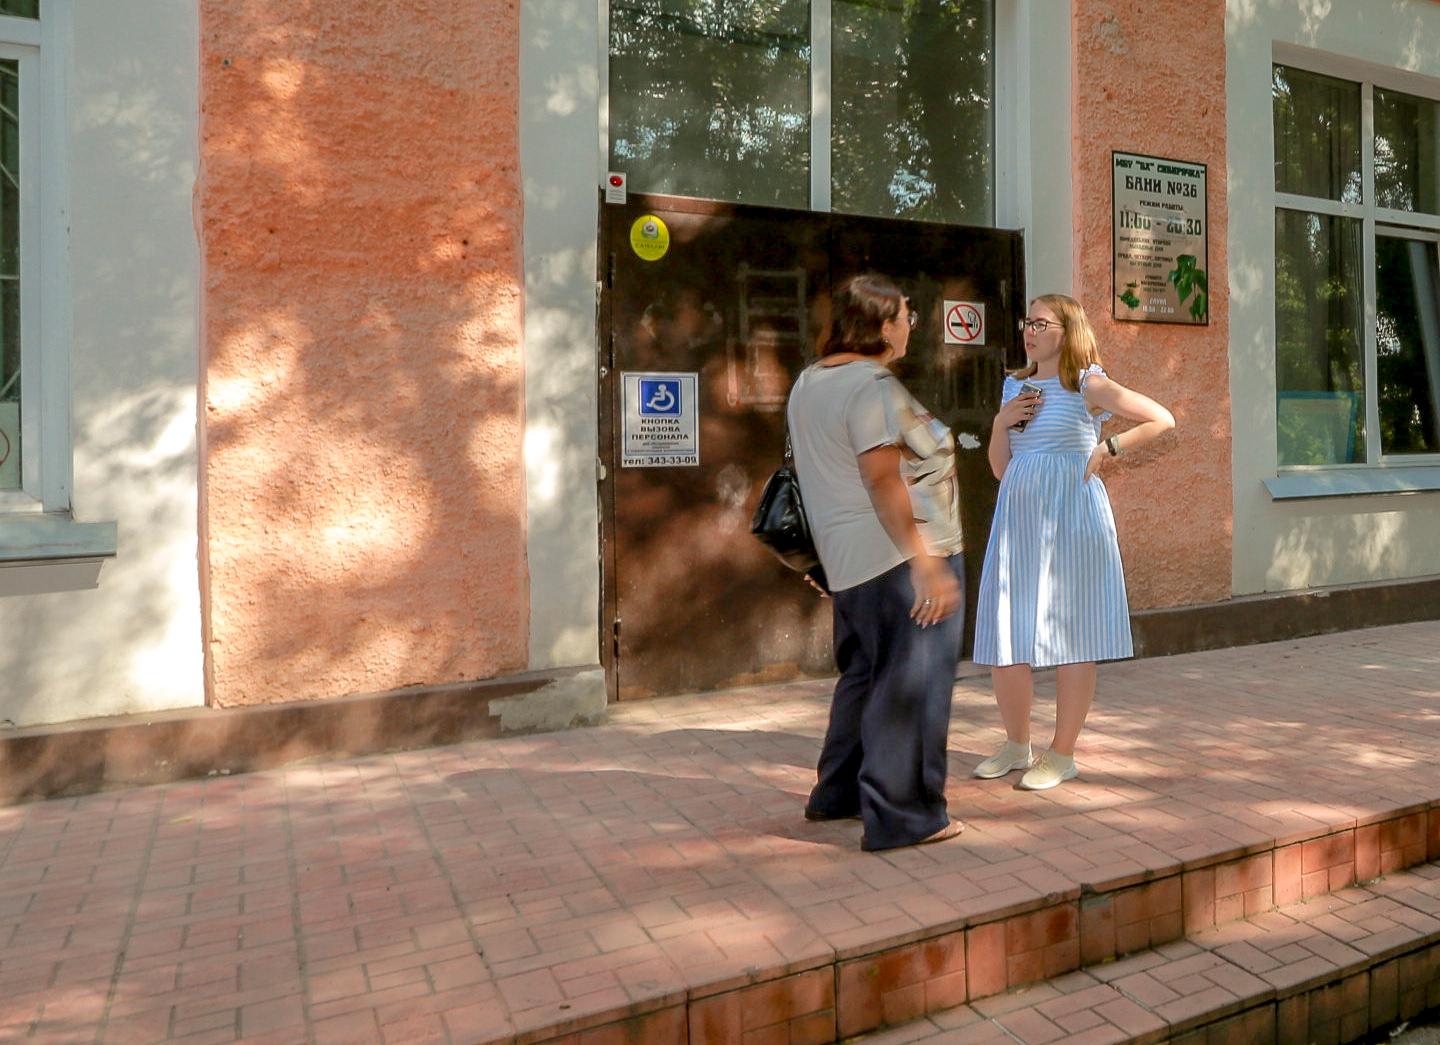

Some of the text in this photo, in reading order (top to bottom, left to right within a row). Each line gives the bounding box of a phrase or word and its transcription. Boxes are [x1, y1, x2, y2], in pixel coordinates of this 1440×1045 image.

[1125, 175, 1197, 198] БАНИ №36
[647, 456, 698, 465] 343-33-09
